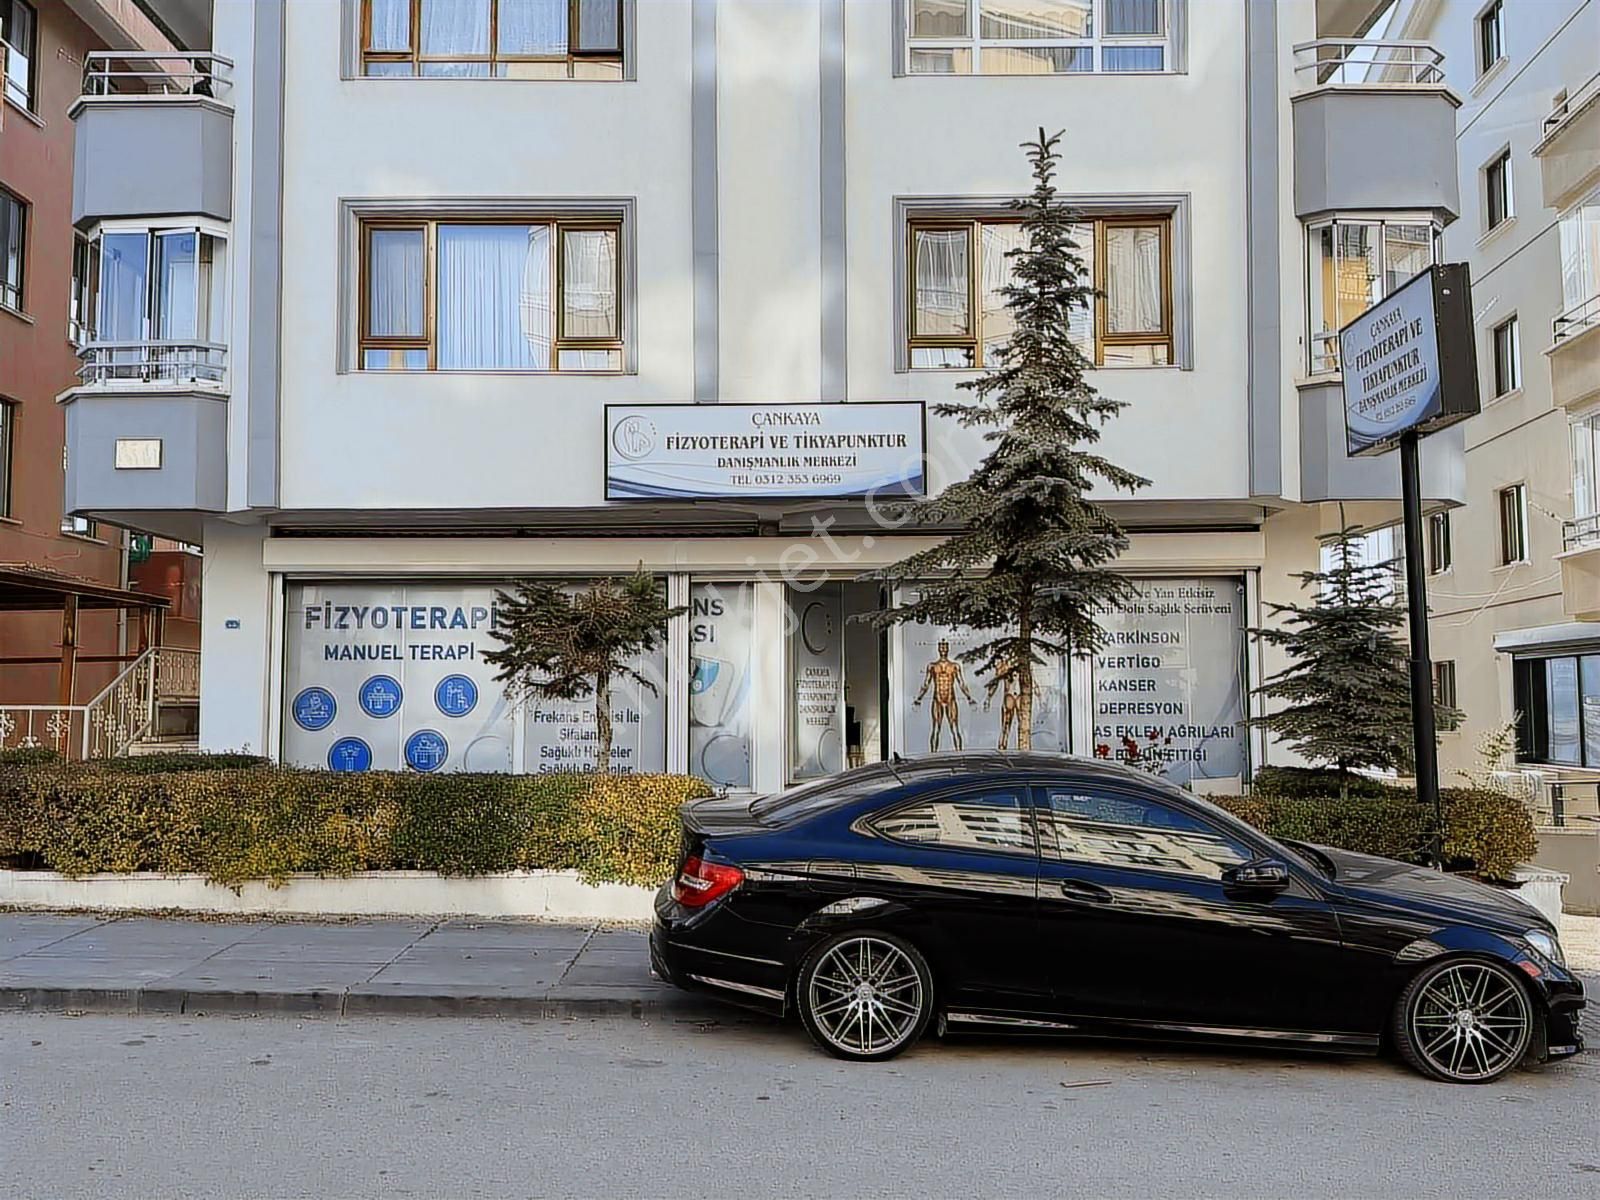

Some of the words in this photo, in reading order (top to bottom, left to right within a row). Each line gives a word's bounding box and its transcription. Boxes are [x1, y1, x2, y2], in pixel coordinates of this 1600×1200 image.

[1409, 317, 1423, 339] VE
[751, 411, 821, 429] ÇANKAYA
[666, 430, 765, 450] FİZYOTERAPİ
[770, 434, 789, 449] VE
[793, 430, 907, 449] TİKYAPUNKTUR
[717, 454, 801, 470] DANIŞMANLIK
[803, 452, 857, 468] MERKEZİ
[730, 473, 752, 486] TEL
[754, 473, 785, 486] 0312
[811, 472, 842, 485] 6969
[305, 601, 498, 630] FİZYOTERAPİ
[1147, 603, 1181, 617] Sağlık
[1184, 602, 1232, 615] Serüveni
[324, 643, 404, 661] MANUEL
[408, 642, 475, 661] TERAPİ
[1098, 653, 1161, 669] VERTİGO
[1099, 679, 1157, 692] KANSER
[1099, 702, 1184, 715] DEPRESYON
[534, 710, 580, 723] Frekans
[1116, 725, 1164, 738] EKLEM
[1168, 724, 1234, 738] AĞRILARI
[584, 745, 632, 759] Hüeler
